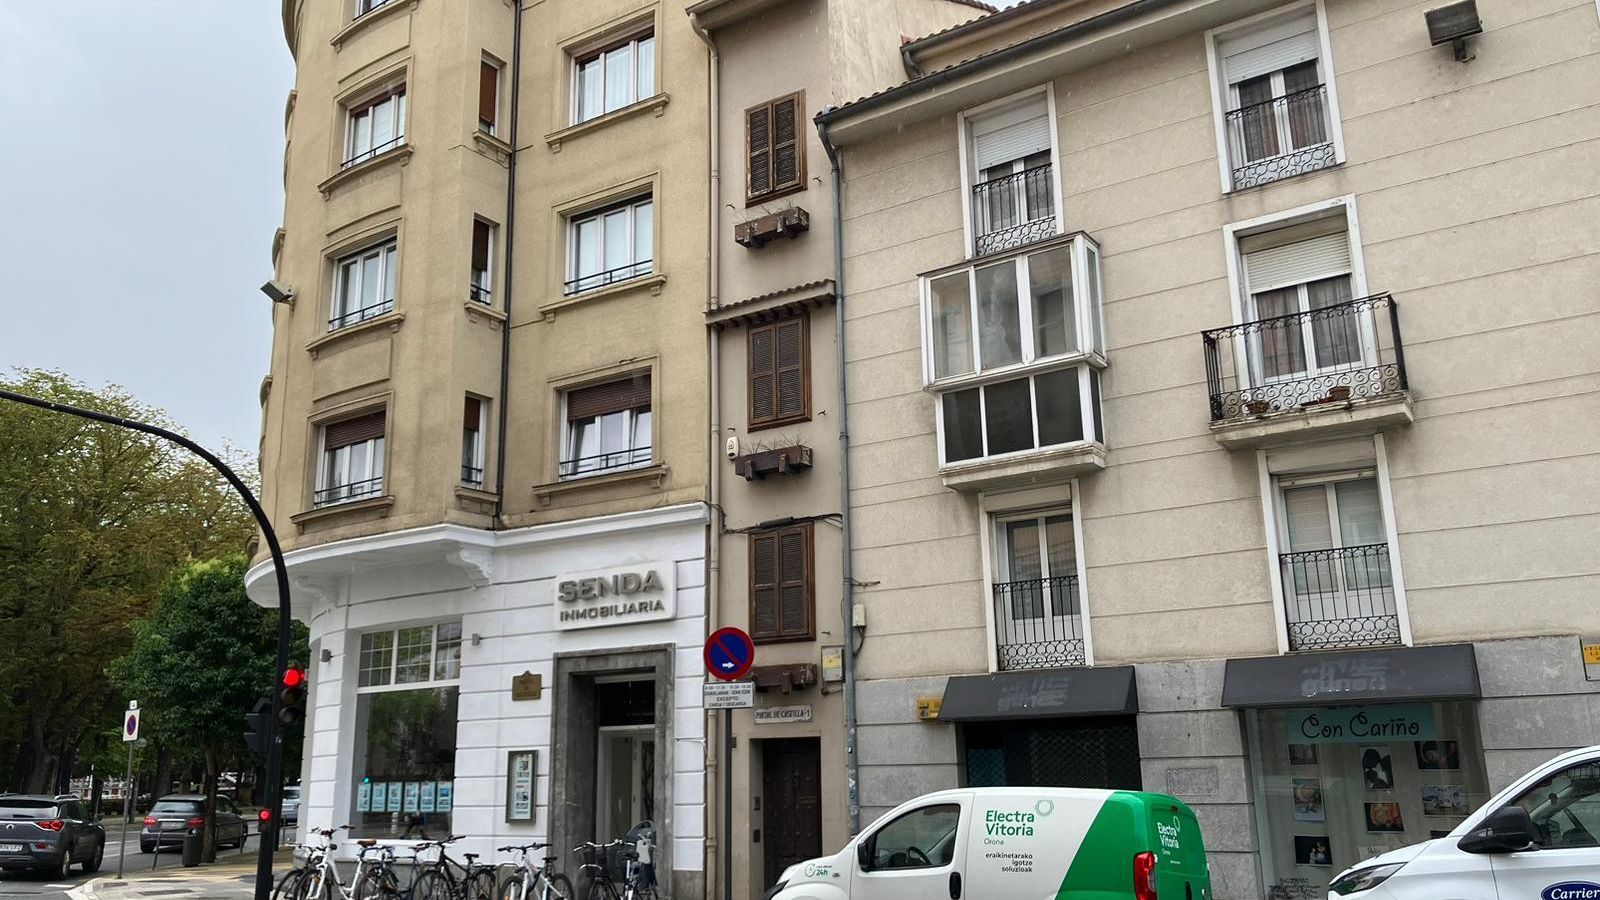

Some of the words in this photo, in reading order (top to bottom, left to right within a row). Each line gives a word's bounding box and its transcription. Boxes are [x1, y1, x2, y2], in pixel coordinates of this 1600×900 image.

[558, 570, 664, 603] SENDA
[560, 600, 664, 621] INMOBILIARIA
[1301, 712, 1343, 739] Con
[1350, 711, 1420, 737] Cariño
[985, 810, 1035, 823] Electra
[985, 823, 1034, 836] Vitoria
[1551, 888, 1600, 900] Carrier
